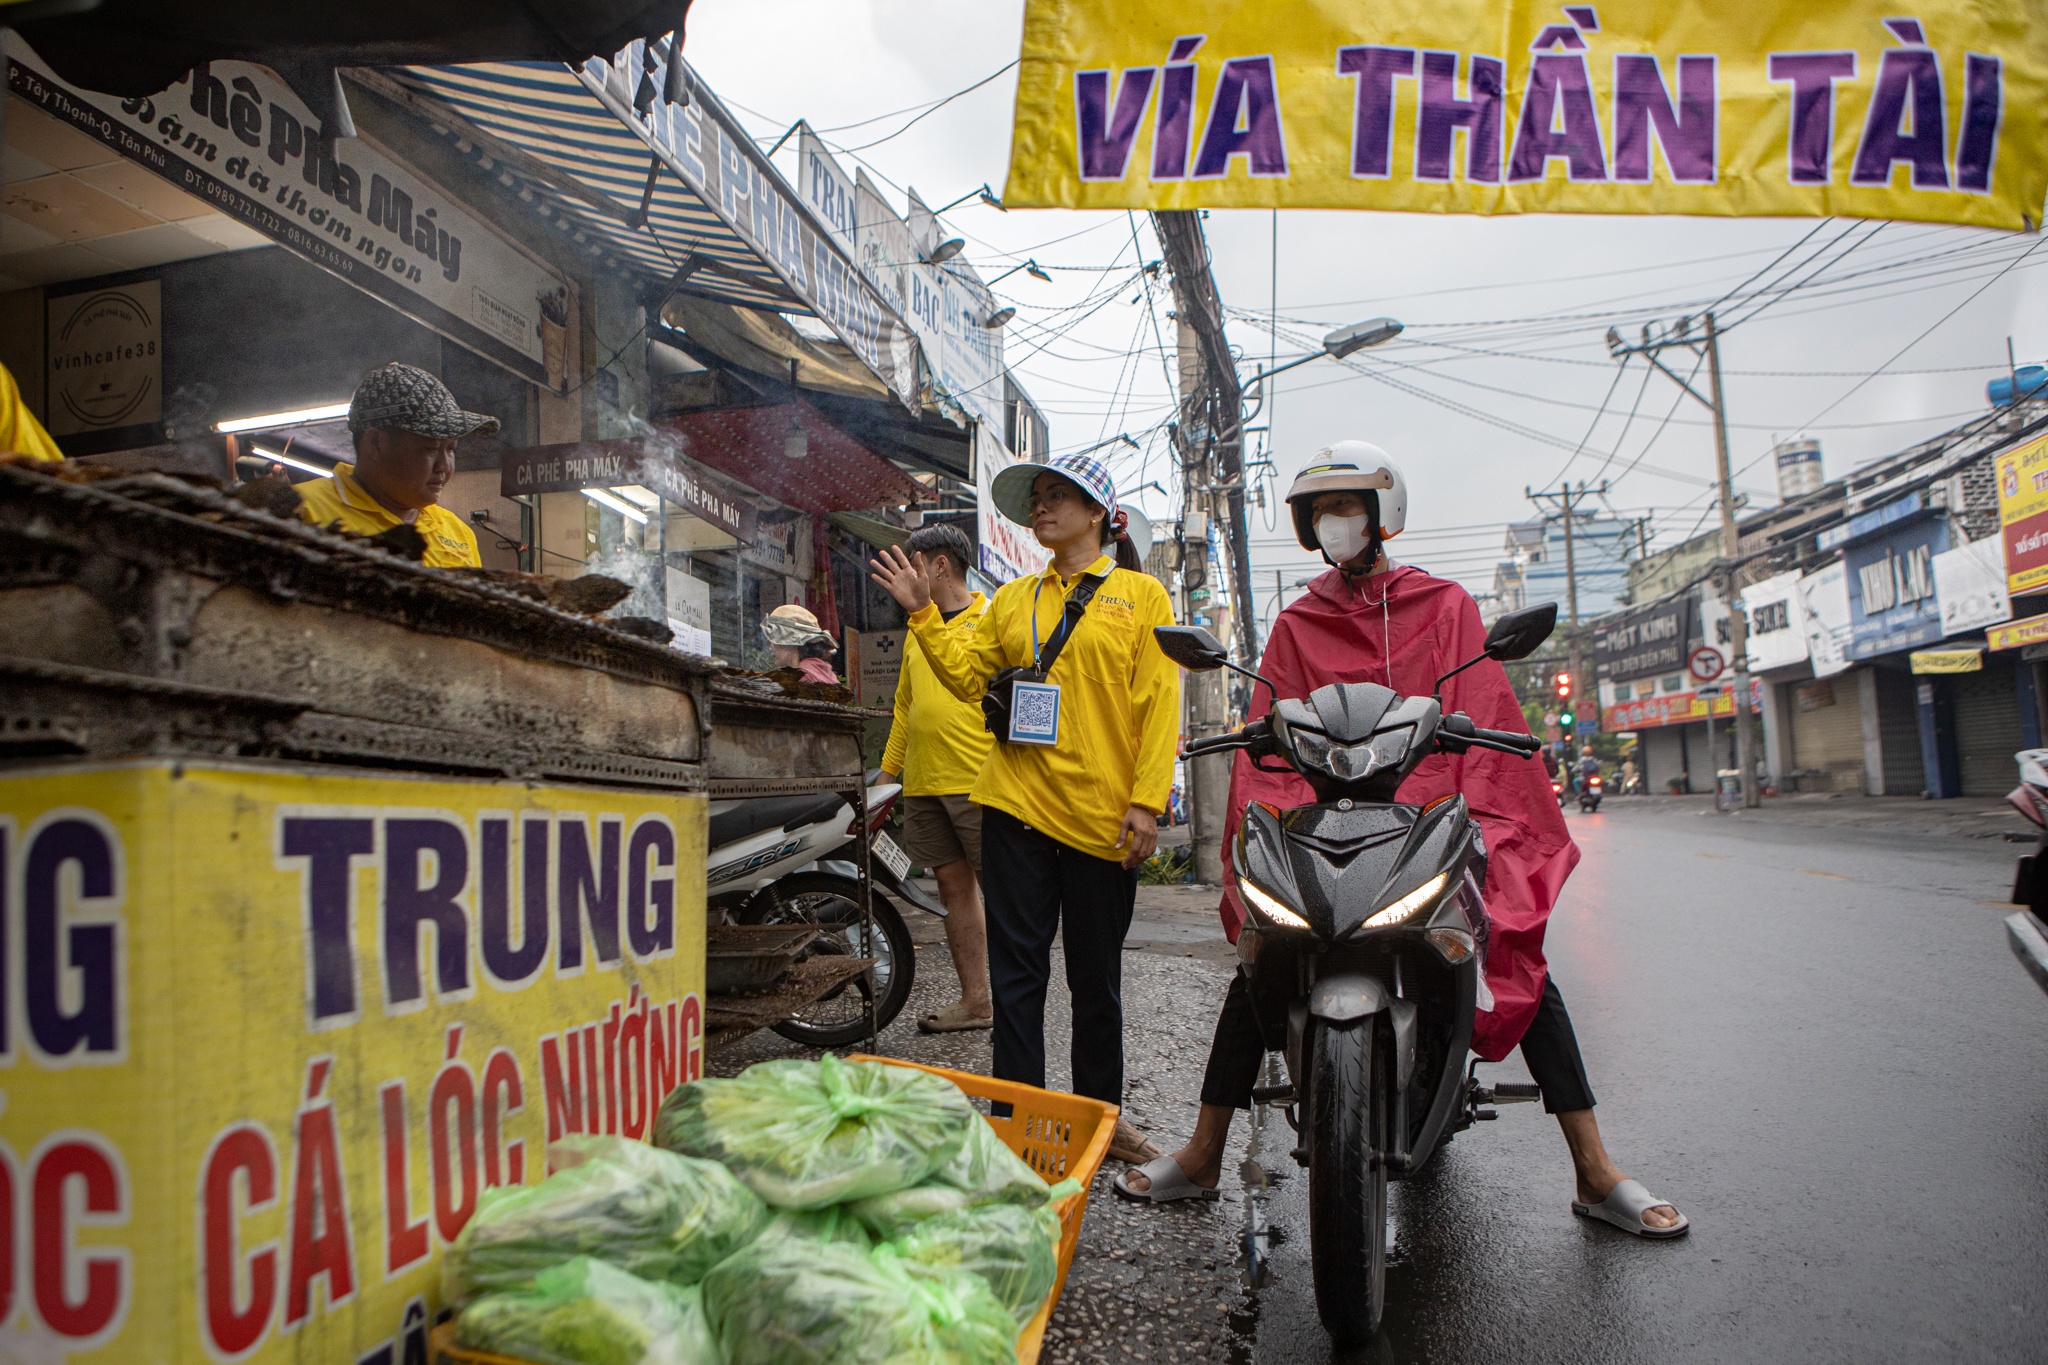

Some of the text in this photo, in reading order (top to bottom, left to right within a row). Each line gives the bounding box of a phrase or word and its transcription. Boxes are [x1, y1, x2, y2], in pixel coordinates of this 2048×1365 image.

[26, 75, 51, 104] Tây
[119, 131, 141, 154] Tân
[145, 145, 167, 168] Phú
[1074, 7, 2000, 192] VÍA THẦN TÀI
[225, 156, 271, 195] đà
[276, 185, 352, 243] thơm
[355, 236, 422, 284] ngon
[367, 173, 461, 283] Máy
[717, 125, 807, 294] PHA
[912, 271, 940, 335] BẠC
[54, 341, 156, 370] Vinhcafe38
[517, 452, 621, 486] CÀ PHÊ PHA MÁY
[665, 467, 742, 529] CÀ PHÊ PHA MÁY
[1098, 594, 1136, 611] TRUNG
[1640, 613, 1679, 644] KÍNH
[283, 818, 676, 1020] TRUNG
[205, 984, 700, 1355] CÁ LÓC NƯỚNG
